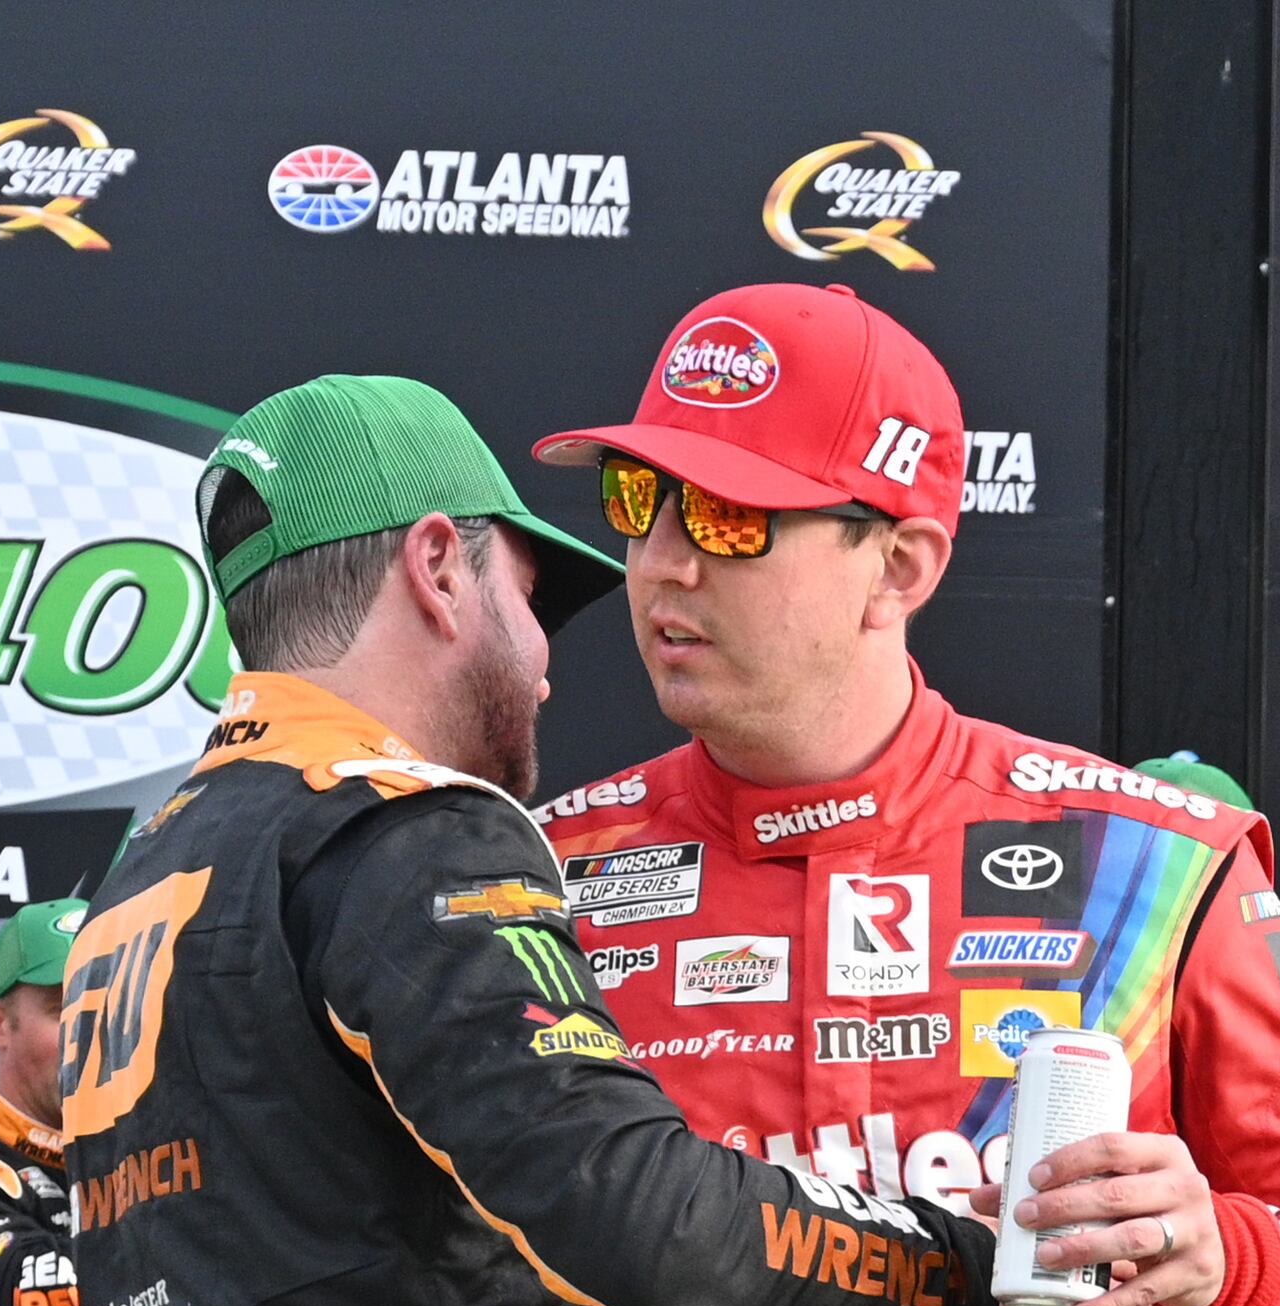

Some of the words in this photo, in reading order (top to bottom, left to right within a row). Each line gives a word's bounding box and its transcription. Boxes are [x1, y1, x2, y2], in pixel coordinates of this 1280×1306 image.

[3, 170, 106, 199] STATE
[384, 150, 629, 206] ATLANTA
[814, 162, 960, 199] QUAKER
[377, 201, 476, 233] MOTOR
[481, 203, 629, 238] SPEEDWAY
[827, 192, 935, 220] STATE
[667, 338, 769, 387] Skittles
[864, 417, 931, 486] 18
[960, 481, 1036, 514] DWAY
[1010, 752, 1219, 821] Skittles
[753, 792, 877, 844] Skittles
[608, 848, 683, 876] NASCAR
[579, 879, 614, 902] CUP
[616, 874, 681, 897] SERIES
[602, 904, 666, 924] CHAMPION
[669, 901, 687, 916] 2X
[590, 949, 656, 976] Clips
[955, 935, 1078, 963] SNICKERS
[683, 957, 779, 978] INTERSTATE
[686, 971, 773, 990] BATTERIES
[834, 964, 921, 981] ROWDY
[631, 1029, 795, 1060] GOODYEAR
